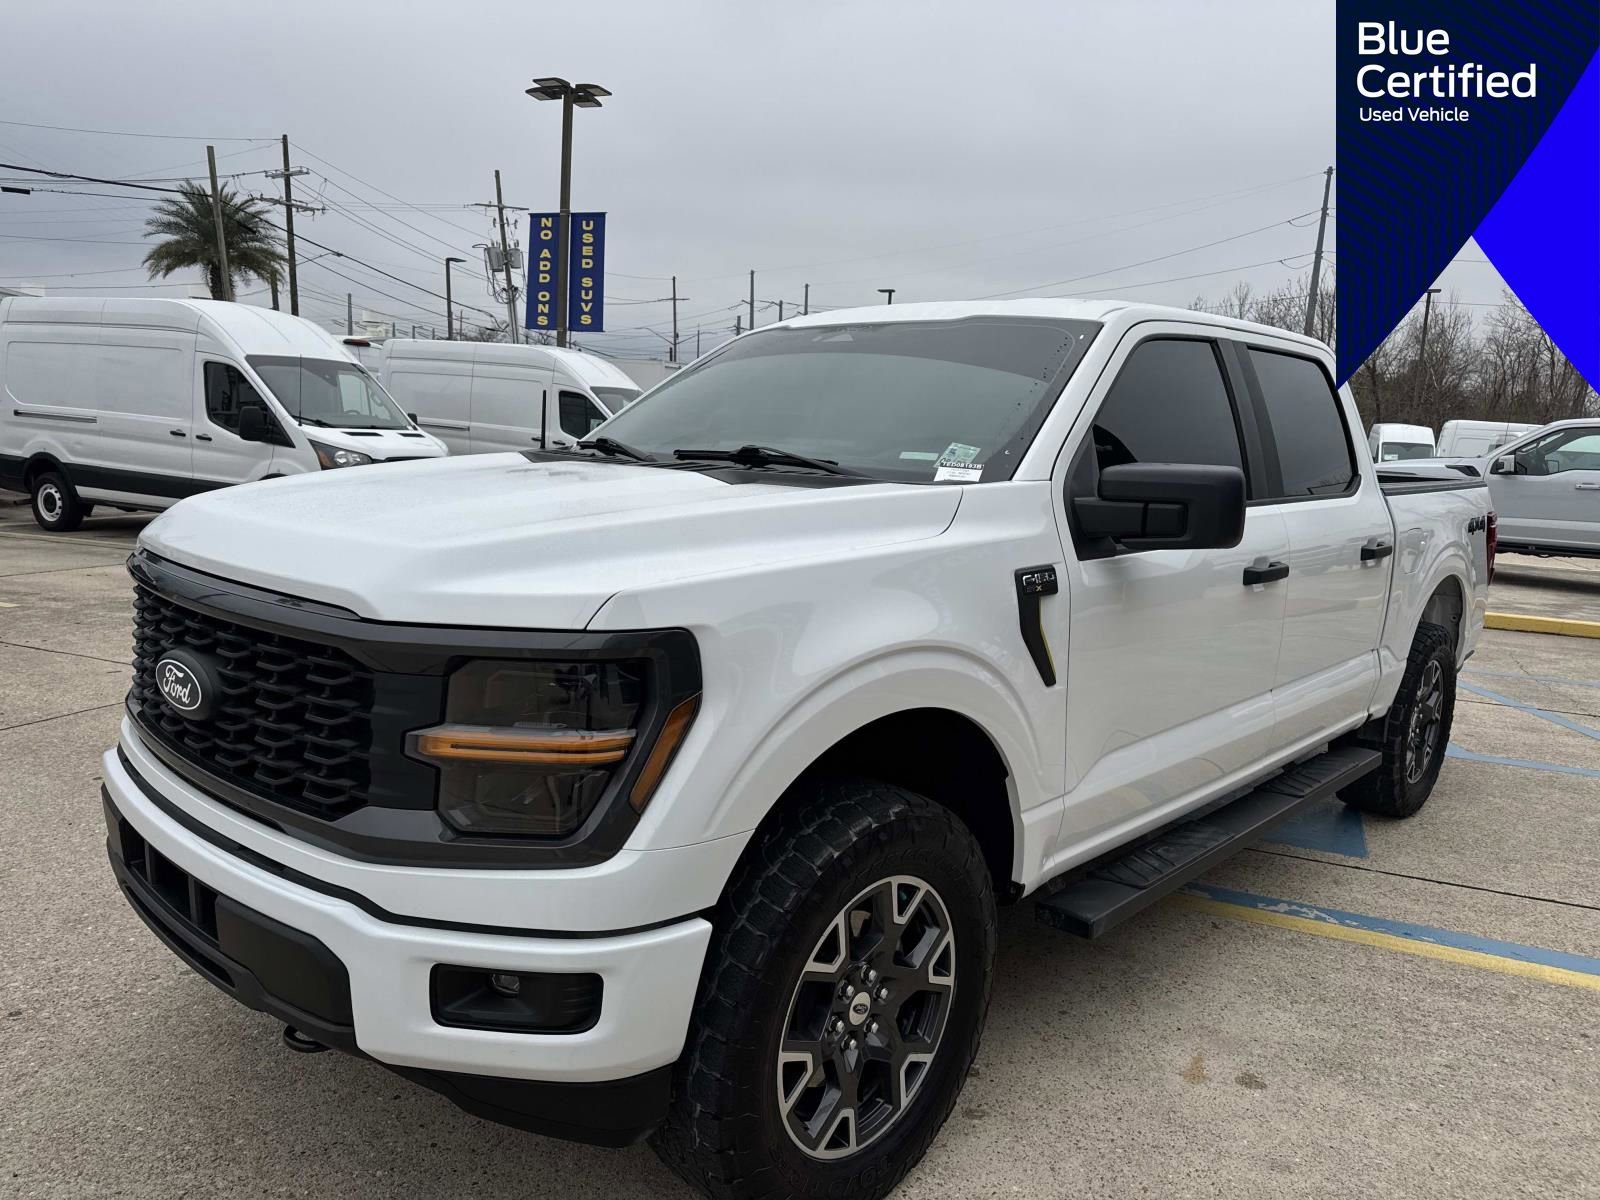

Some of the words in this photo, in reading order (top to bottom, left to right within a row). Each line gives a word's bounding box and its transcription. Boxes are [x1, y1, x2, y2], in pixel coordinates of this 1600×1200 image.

[540, 217, 552, 240] NO
[581, 220, 594, 269] USED
[538, 249, 551, 283] ADD
[537, 291, 550, 326] ONS
[580, 277, 593, 325] SUVS
[163, 664, 192, 704] Ford
